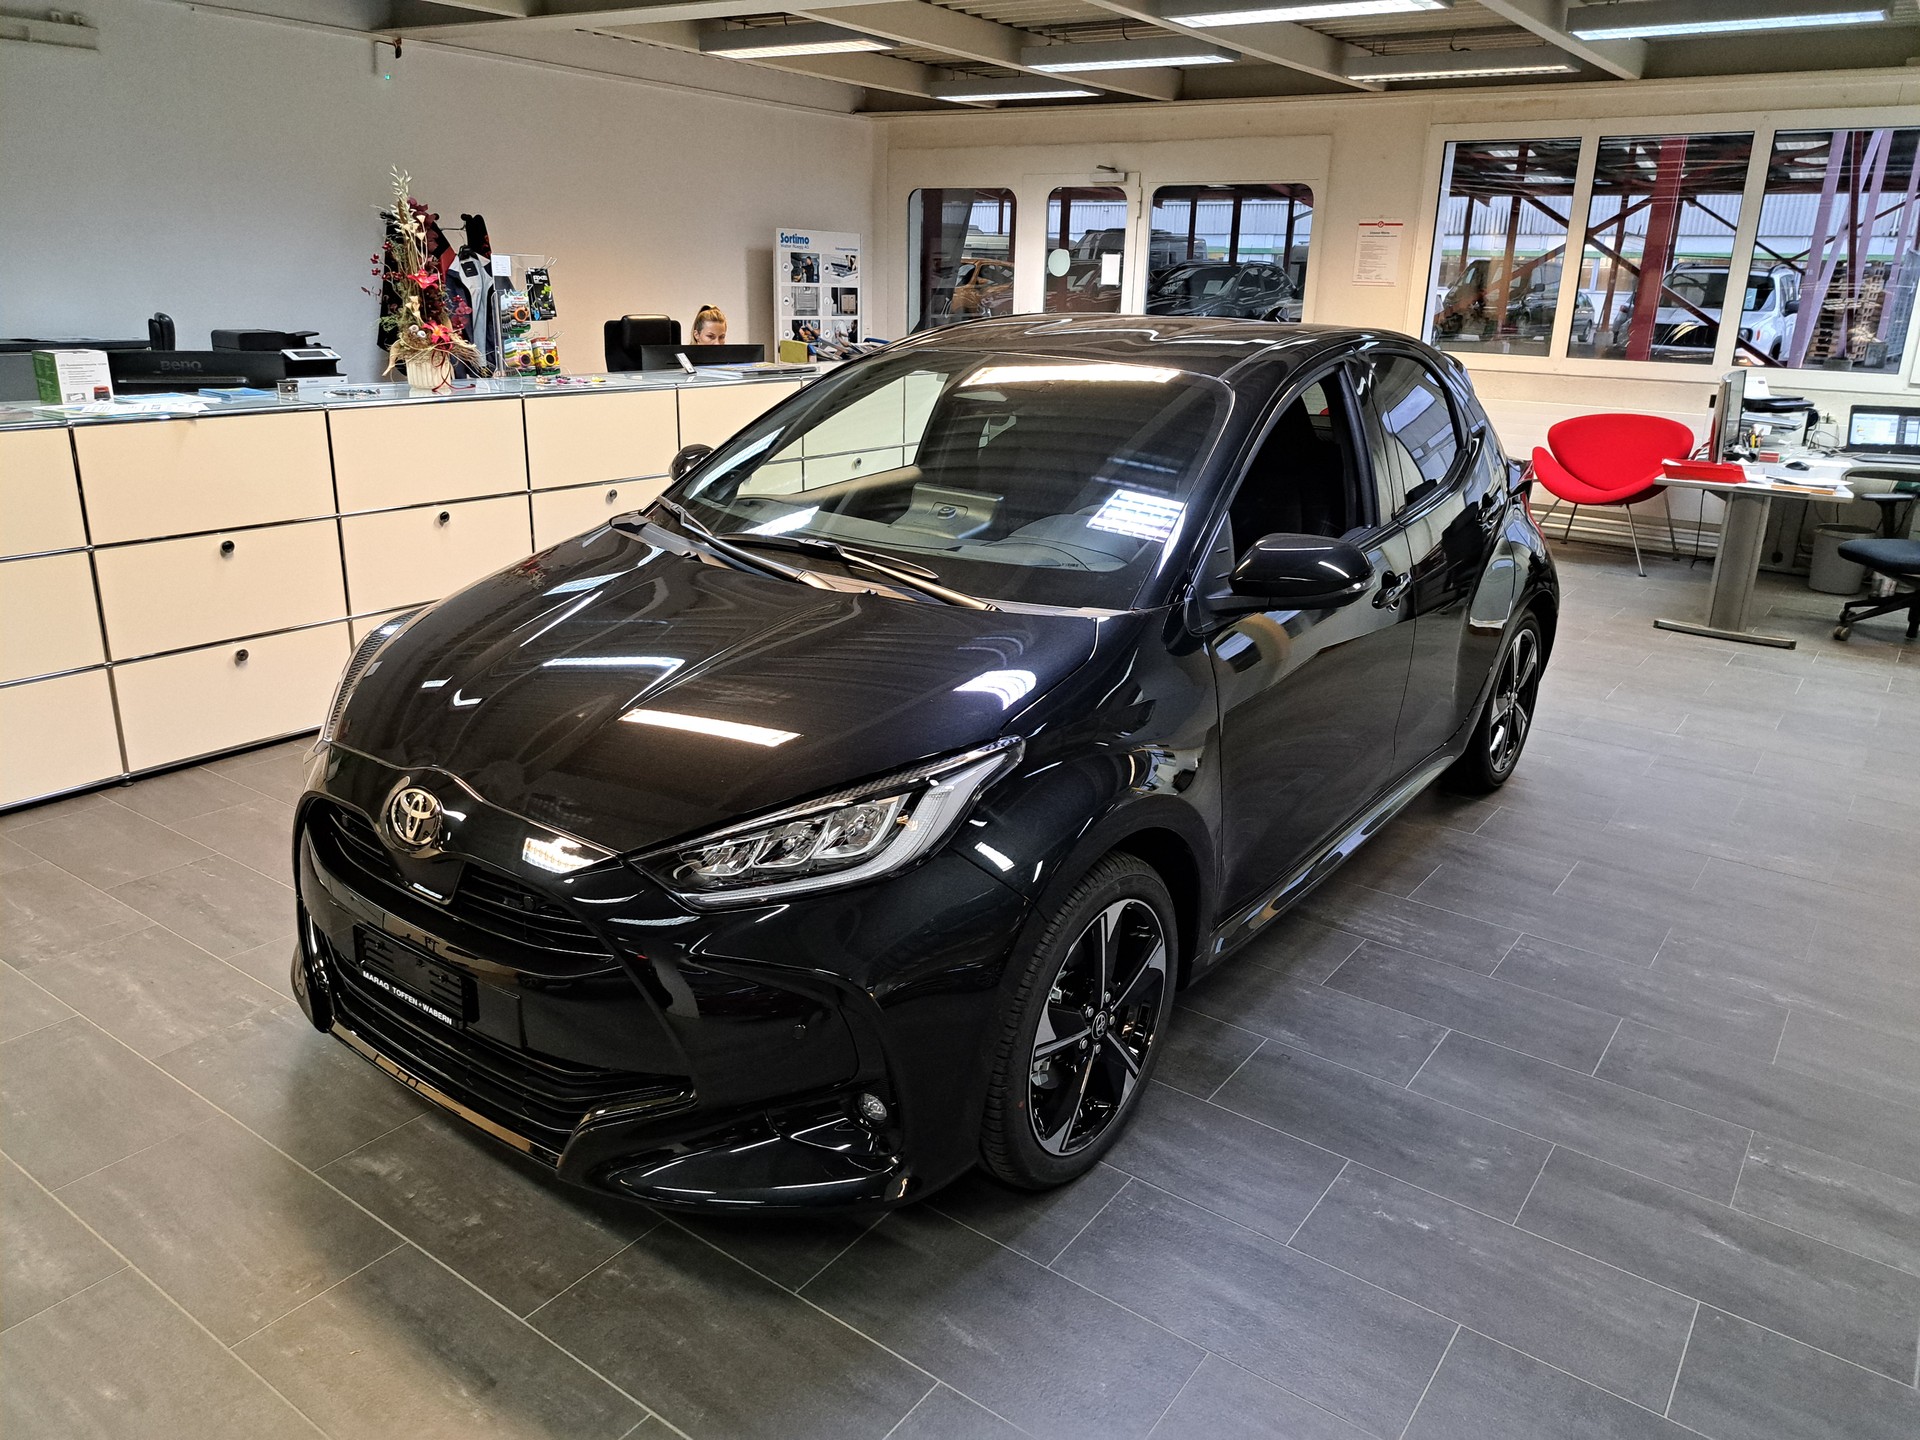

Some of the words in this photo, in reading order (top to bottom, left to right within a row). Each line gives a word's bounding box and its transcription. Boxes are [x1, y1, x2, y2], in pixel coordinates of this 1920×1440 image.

[780, 232, 810, 244] Sortimo
[160, 360, 204, 372] BenQ
[362, 970, 389, 990] MARAG
